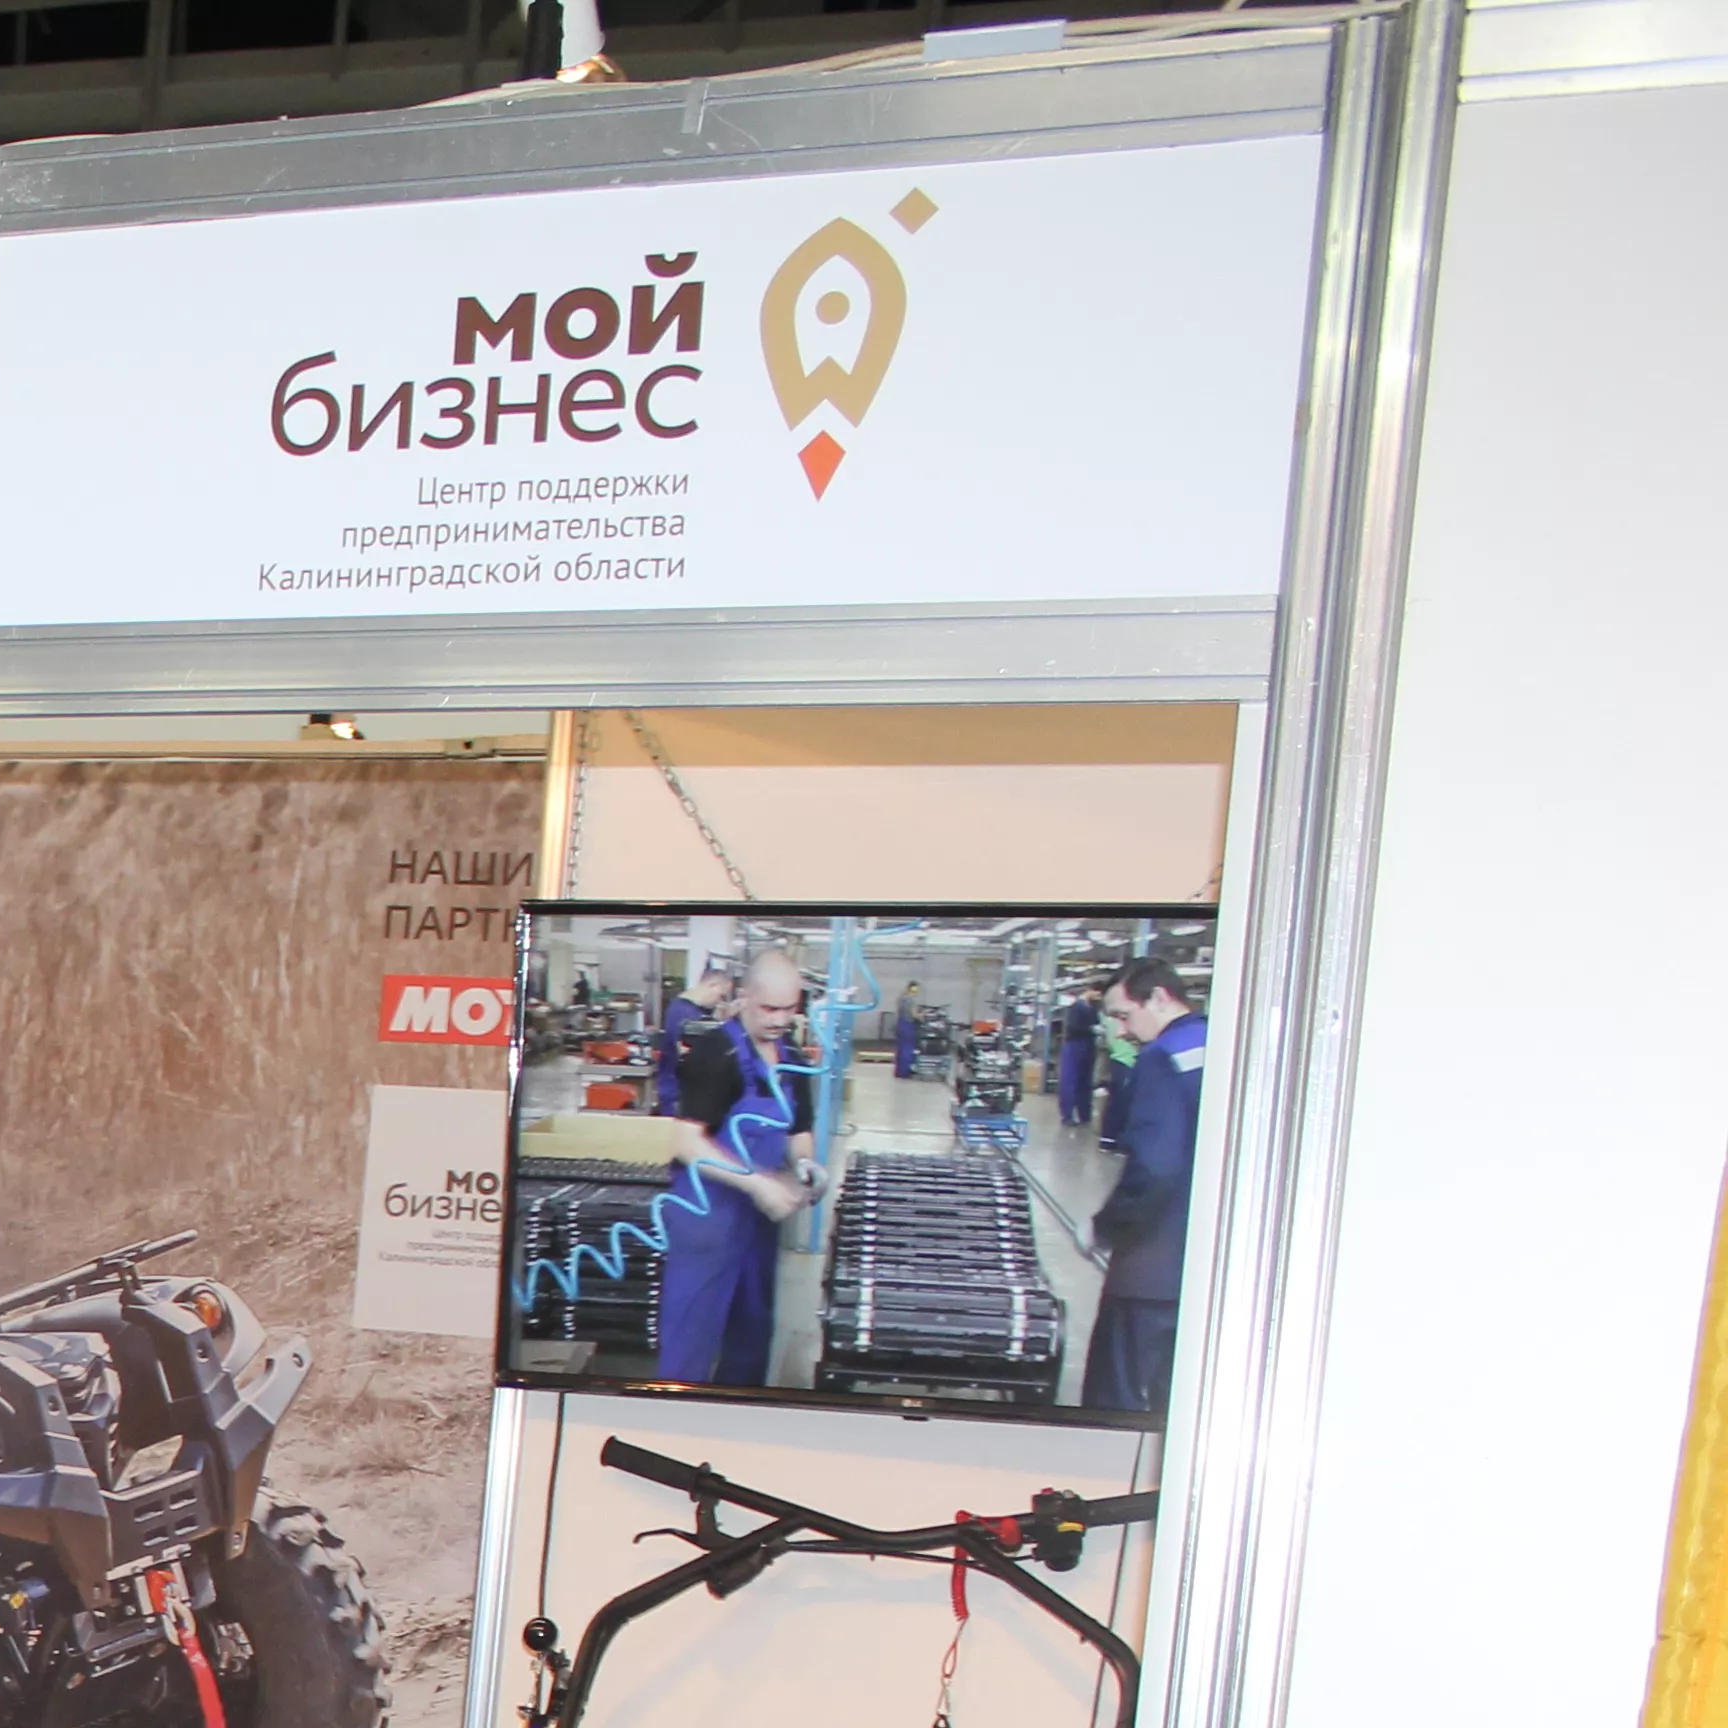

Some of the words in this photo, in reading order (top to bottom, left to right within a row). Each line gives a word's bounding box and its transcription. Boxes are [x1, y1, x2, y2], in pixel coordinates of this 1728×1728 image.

[270, 349, 704, 456] бизнес
[418, 477, 506, 508] Центр
[517, 473, 690, 504] поддержки
[342, 513, 686, 554] предпринимательства
[258, 554, 542, 593] Калининградской
[553, 553, 686, 582] области
[389, 849, 534, 887] НАШИ
[384, 1182, 503, 1223] бизне
